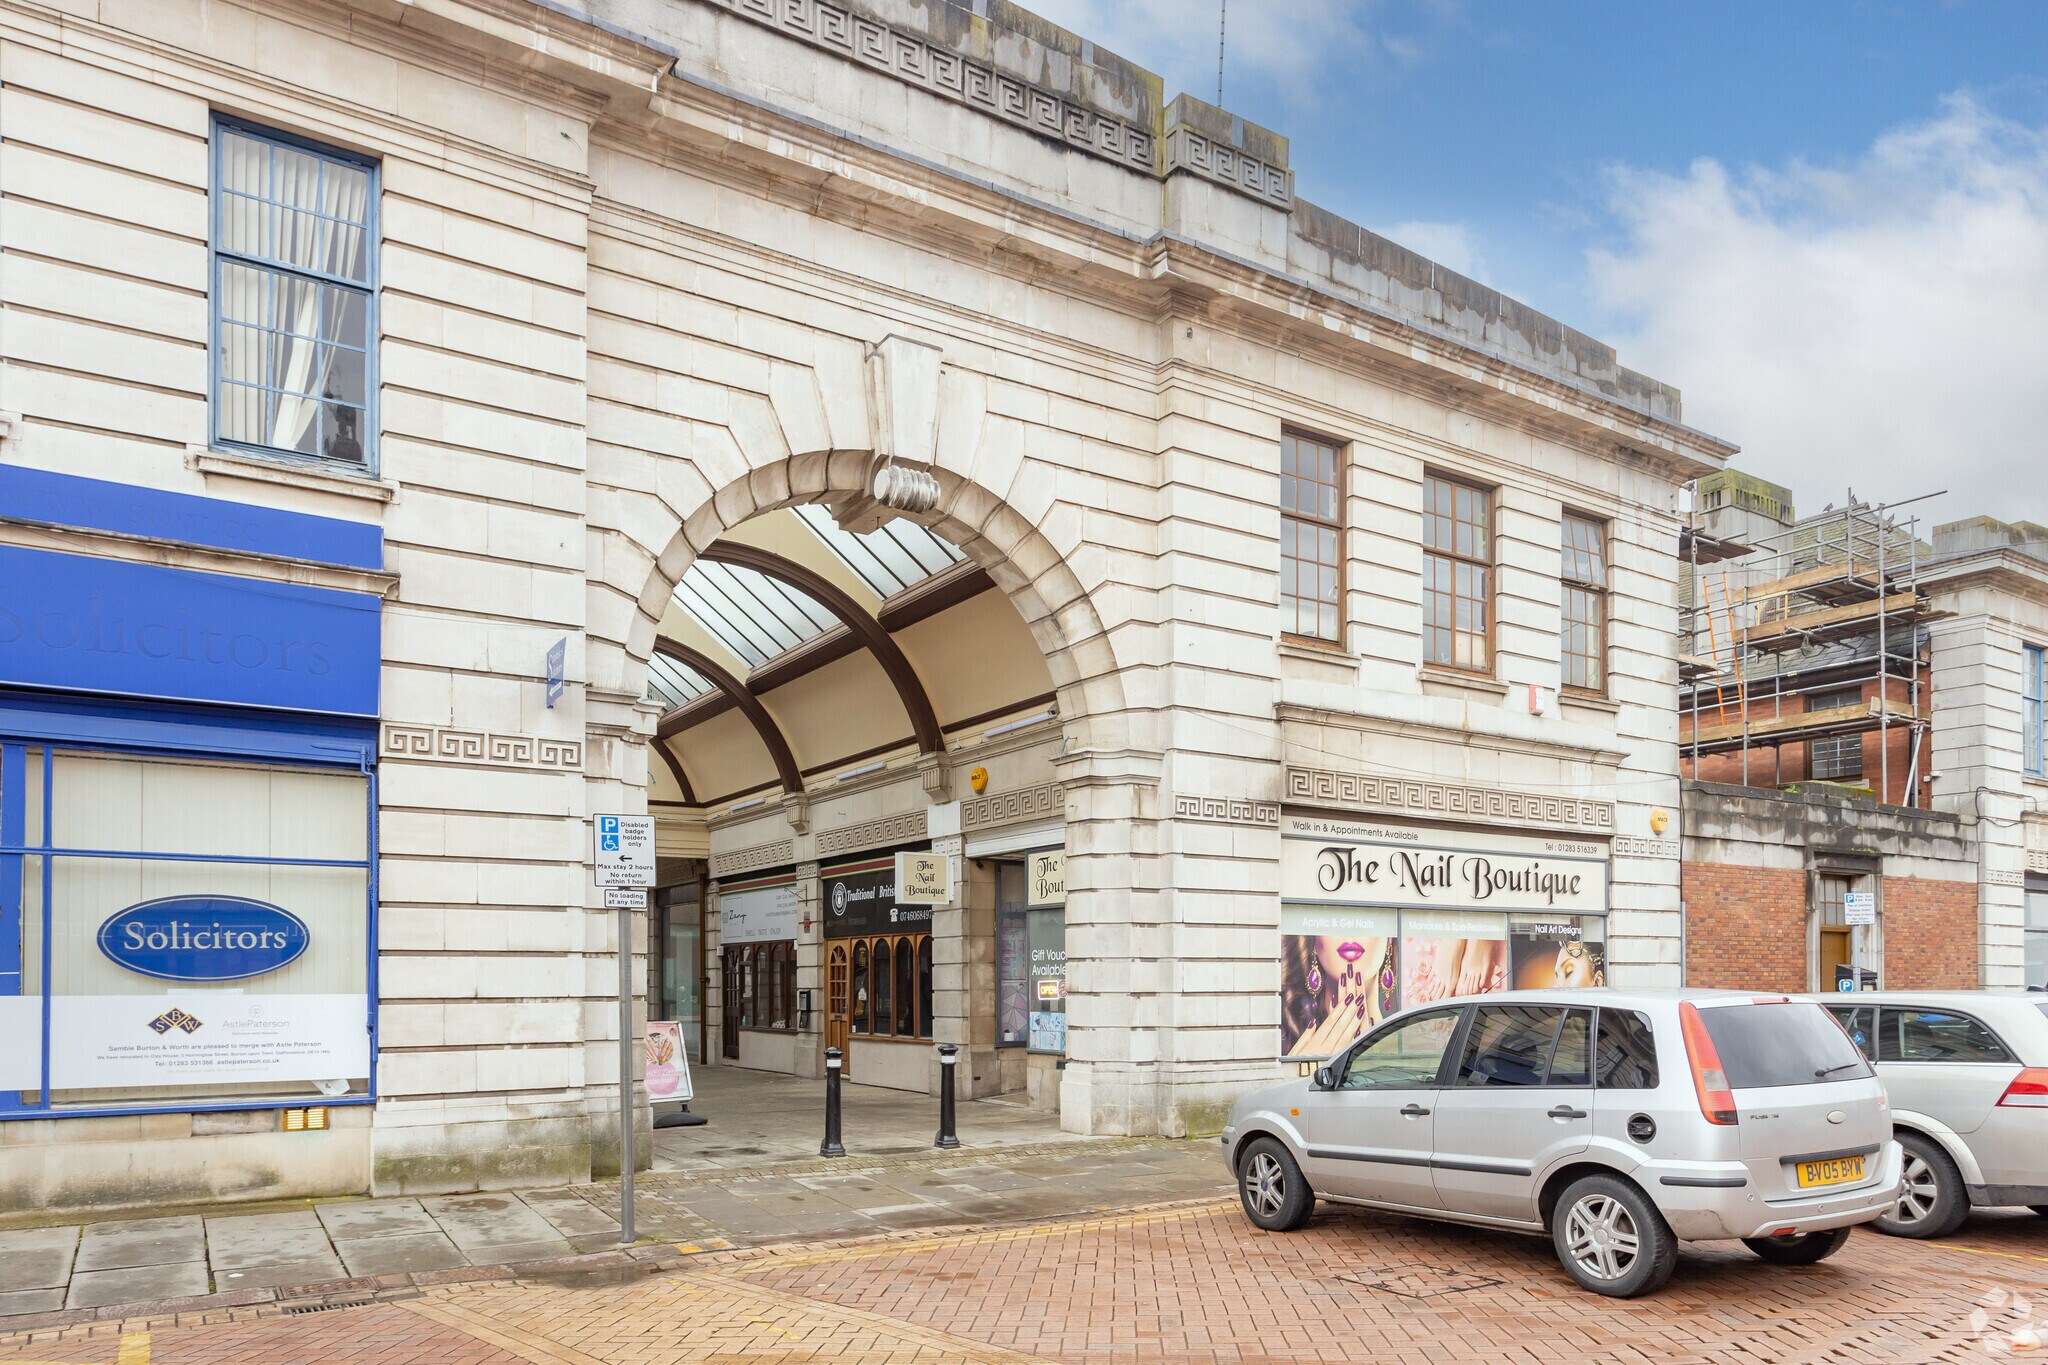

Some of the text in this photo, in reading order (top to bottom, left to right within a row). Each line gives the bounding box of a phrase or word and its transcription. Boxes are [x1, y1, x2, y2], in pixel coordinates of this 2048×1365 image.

[1292, 820, 1419, 841] Walk in & Appointments Available
[1558, 843, 1576, 853] 01283
[1576, 845, 1598, 855] 516339
[916, 860, 934, 871] The
[1036, 856, 1058, 878] The
[915, 873, 935, 884] Nail
[1317, 846, 1581, 906] The Nail Boutique
[620, 892, 644, 900] loading
[847, 886, 876, 902] Traditional
[879, 883, 895, 898] Britis
[905, 885, 945, 897] Boutique
[1302, 917, 1375, 929] Acrylic & Gel Nails
[124, 921, 287, 950] Solicitors
[1535, 924, 1582, 936] Nail Art Designs
[1031, 949, 1067, 962] Gift Vouc
[1031, 964, 1066, 976] Available
[1040, 985, 1058, 995] OPEN
[203, 1043, 229, 1051] pleased
[239, 1043, 260, 1051] merge
[217, 1058, 280, 1066] astlepaterson.co.uk
[1805, 1158, 1862, 1182] BV05 BYW
